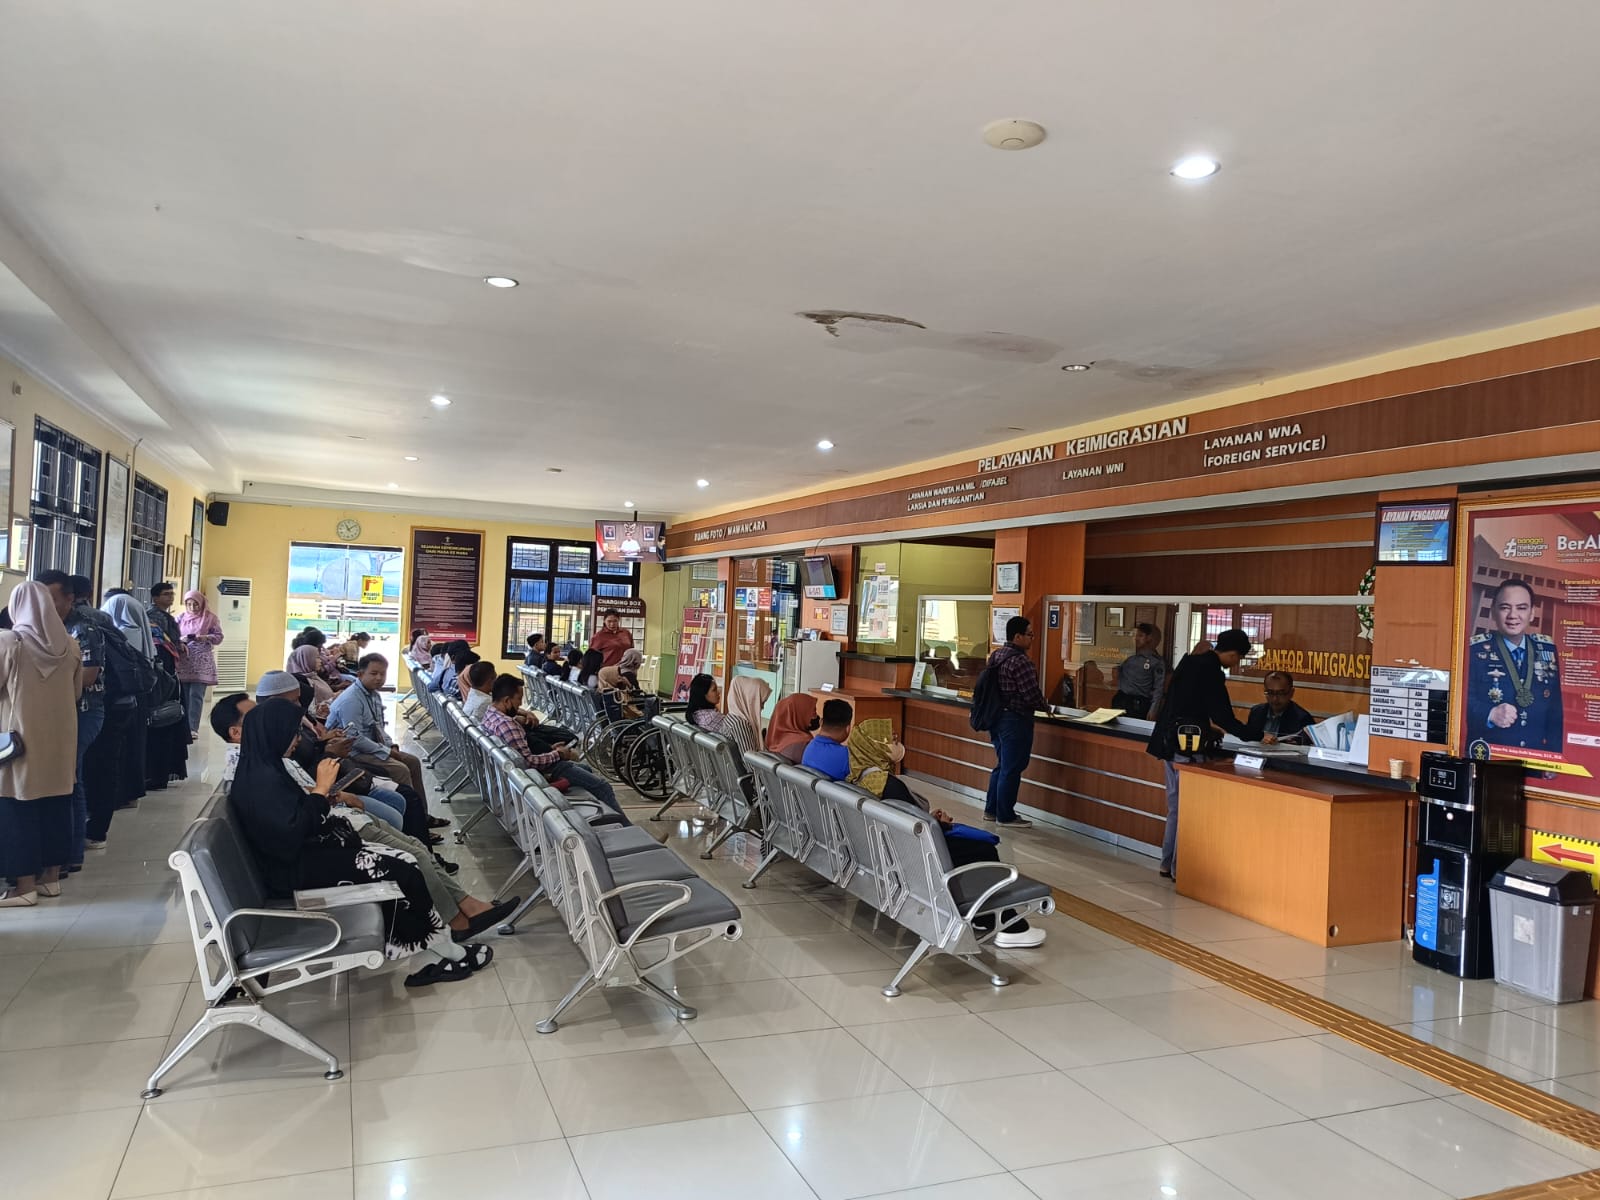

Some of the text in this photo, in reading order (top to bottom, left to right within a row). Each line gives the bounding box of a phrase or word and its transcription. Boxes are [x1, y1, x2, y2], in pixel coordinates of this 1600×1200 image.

[977, 416, 1188, 473] PELAYANAN KEIMIGRASIAN
[1203, 423, 1302, 450] LAYANAN WNA
[1203, 434, 1326, 468] (FOREIGN SERVICE)
[1062, 462, 1125, 481] LAYANAN WNI
[907, 489, 933, 501] LAYANAN
[933, 485, 955, 497] WANITA
[907, 491, 985, 511] LANSIA DAN PENGGANTIAN
[1382, 508, 1450, 522] LAYANAN PENGADUAN
[710, 528, 723, 539] FOTO
[727, 520, 766, 536] WAWANCARA
[597, 598, 628, 606] CHARGING
[1051, 614, 1057, 624] 3
[1307, 651, 1371, 679] IMIGRASI
